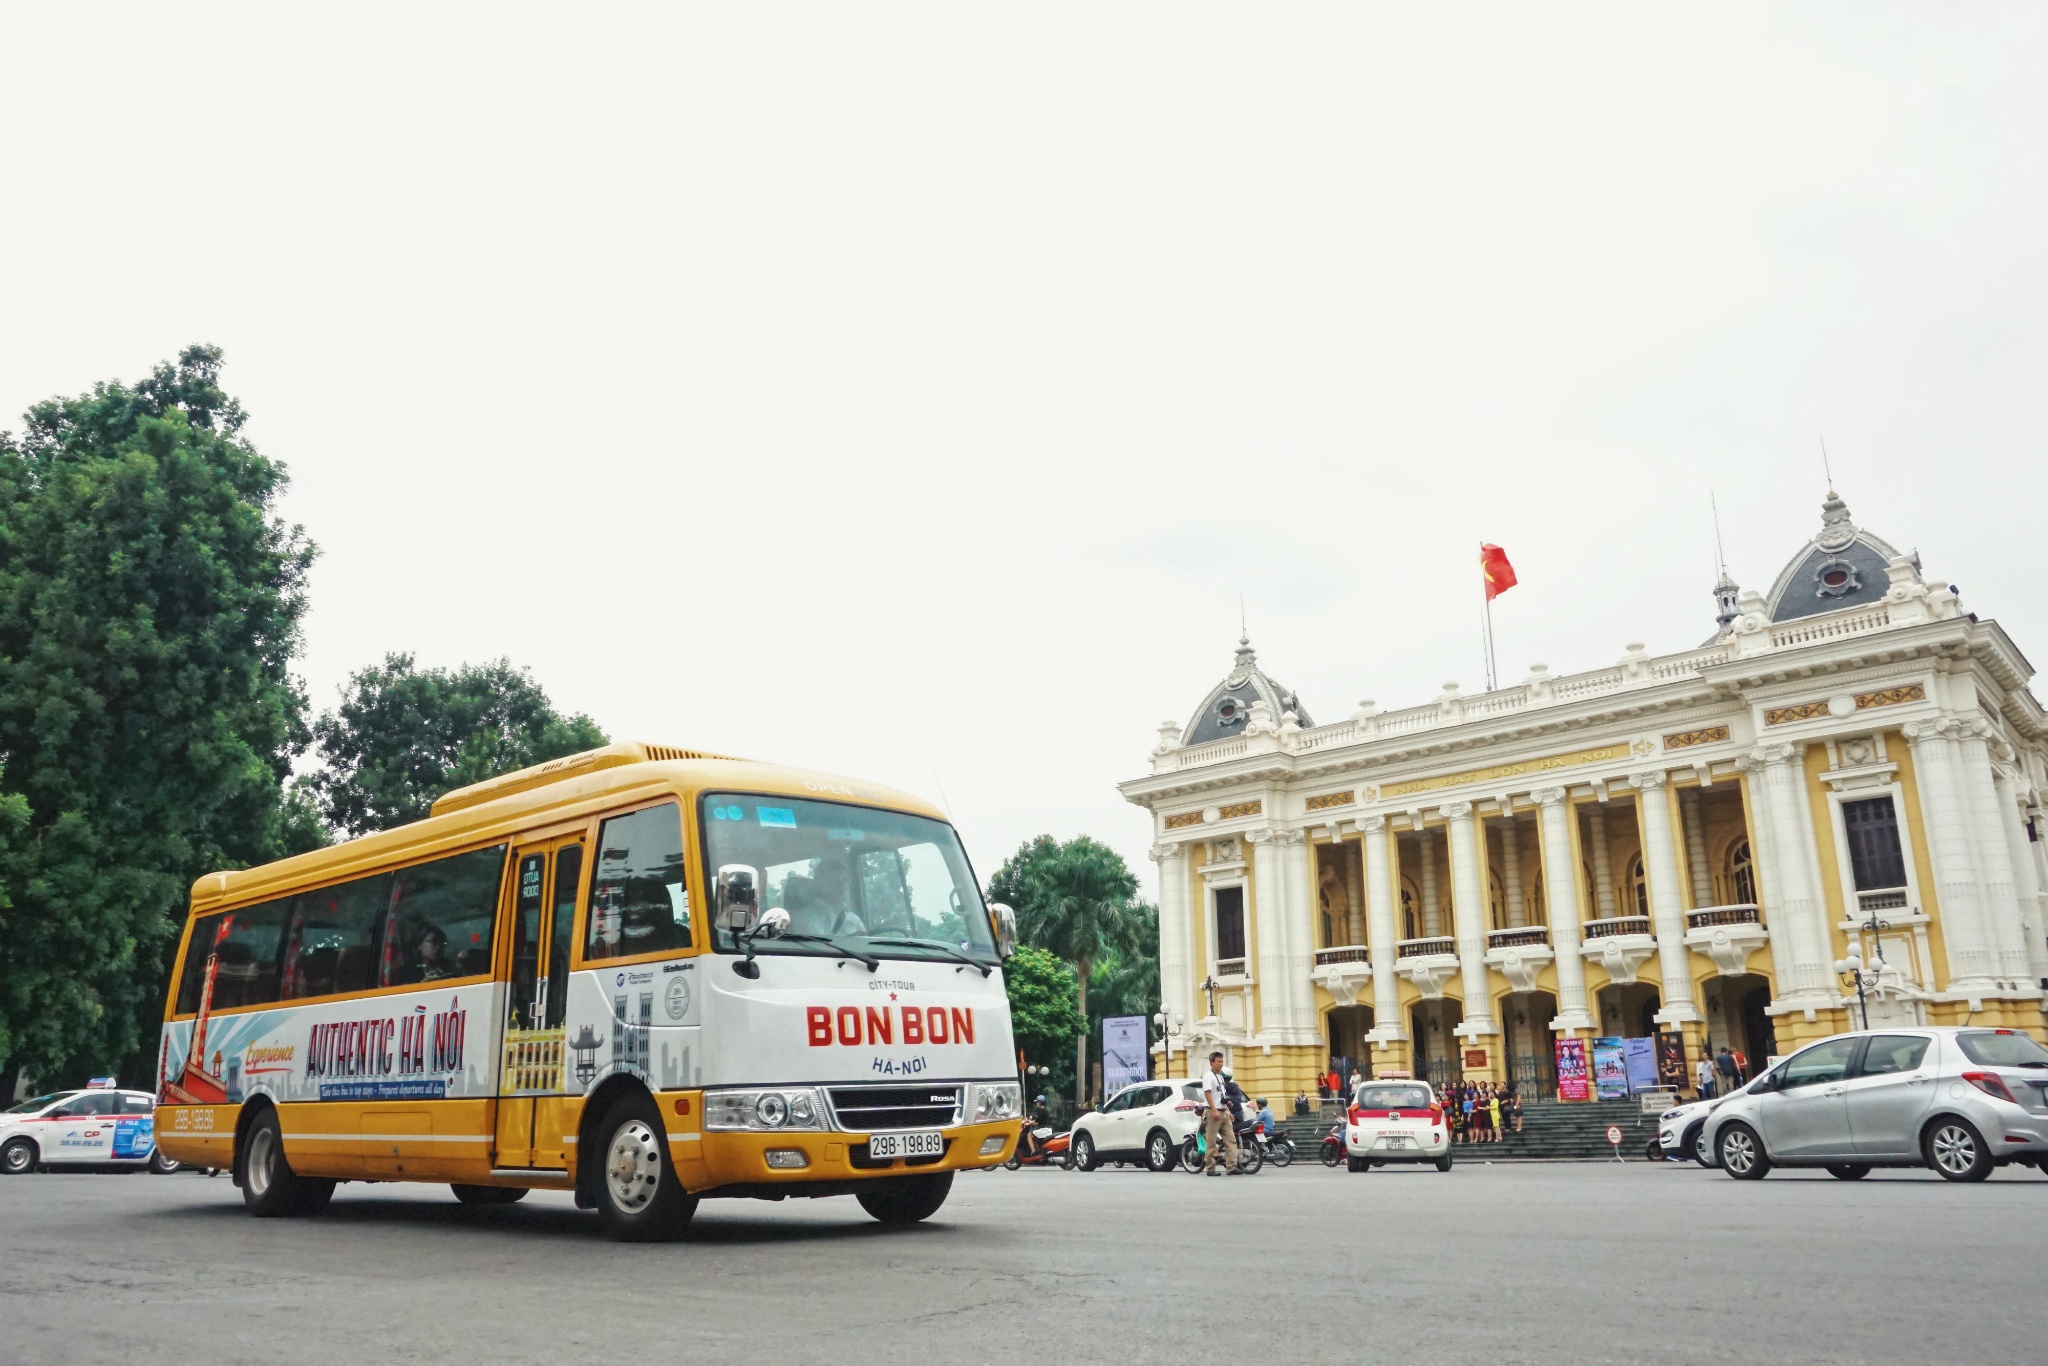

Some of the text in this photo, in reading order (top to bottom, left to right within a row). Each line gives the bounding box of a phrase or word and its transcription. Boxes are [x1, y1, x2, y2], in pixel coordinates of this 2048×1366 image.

[1443, 772, 1477, 787] HÁT
[1540, 755, 1566, 770] HÀ
[1581, 748, 1614, 763] NỘI
[806, 1006, 977, 1047] BON BON
[244, 1039, 295, 1071] Experience
[304, 995, 467, 1088] AUTHENTIC HÀ NỘI
[1107, 1067, 1144, 1077] SAXOPHONE
[321, 1086, 331, 1097] Take
[340, 1084, 349, 1096] bus
[378, 1083, 399, 1099] Frequent
[399, 1083, 425, 1098] departures
[425, 1082, 434, 1094] all
[433, 1082, 444, 1099] day
[83, 1130, 101, 1138] CP
[872, 1133, 941, 1157] 29B-198.89
